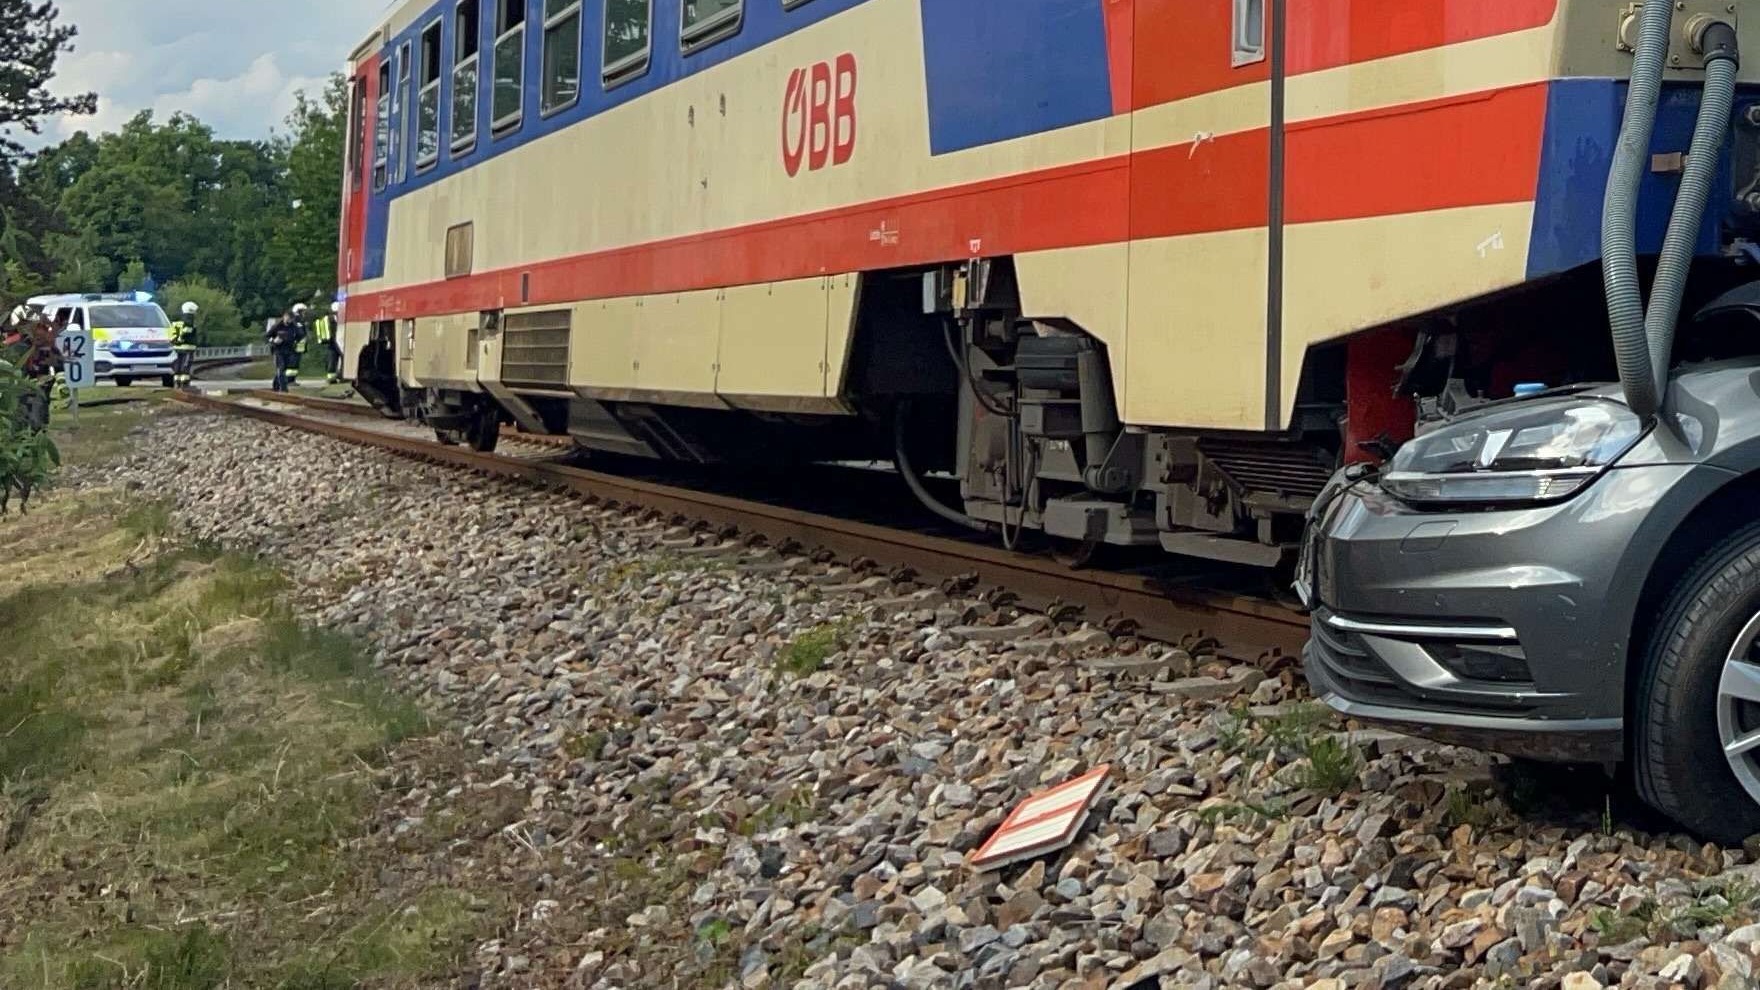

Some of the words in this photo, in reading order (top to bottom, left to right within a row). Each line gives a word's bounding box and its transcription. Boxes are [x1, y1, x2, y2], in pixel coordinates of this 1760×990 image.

[782, 52, 857, 178] ÖBB
[63, 336, 86, 358] 12
[69, 362, 82, 382] 0
